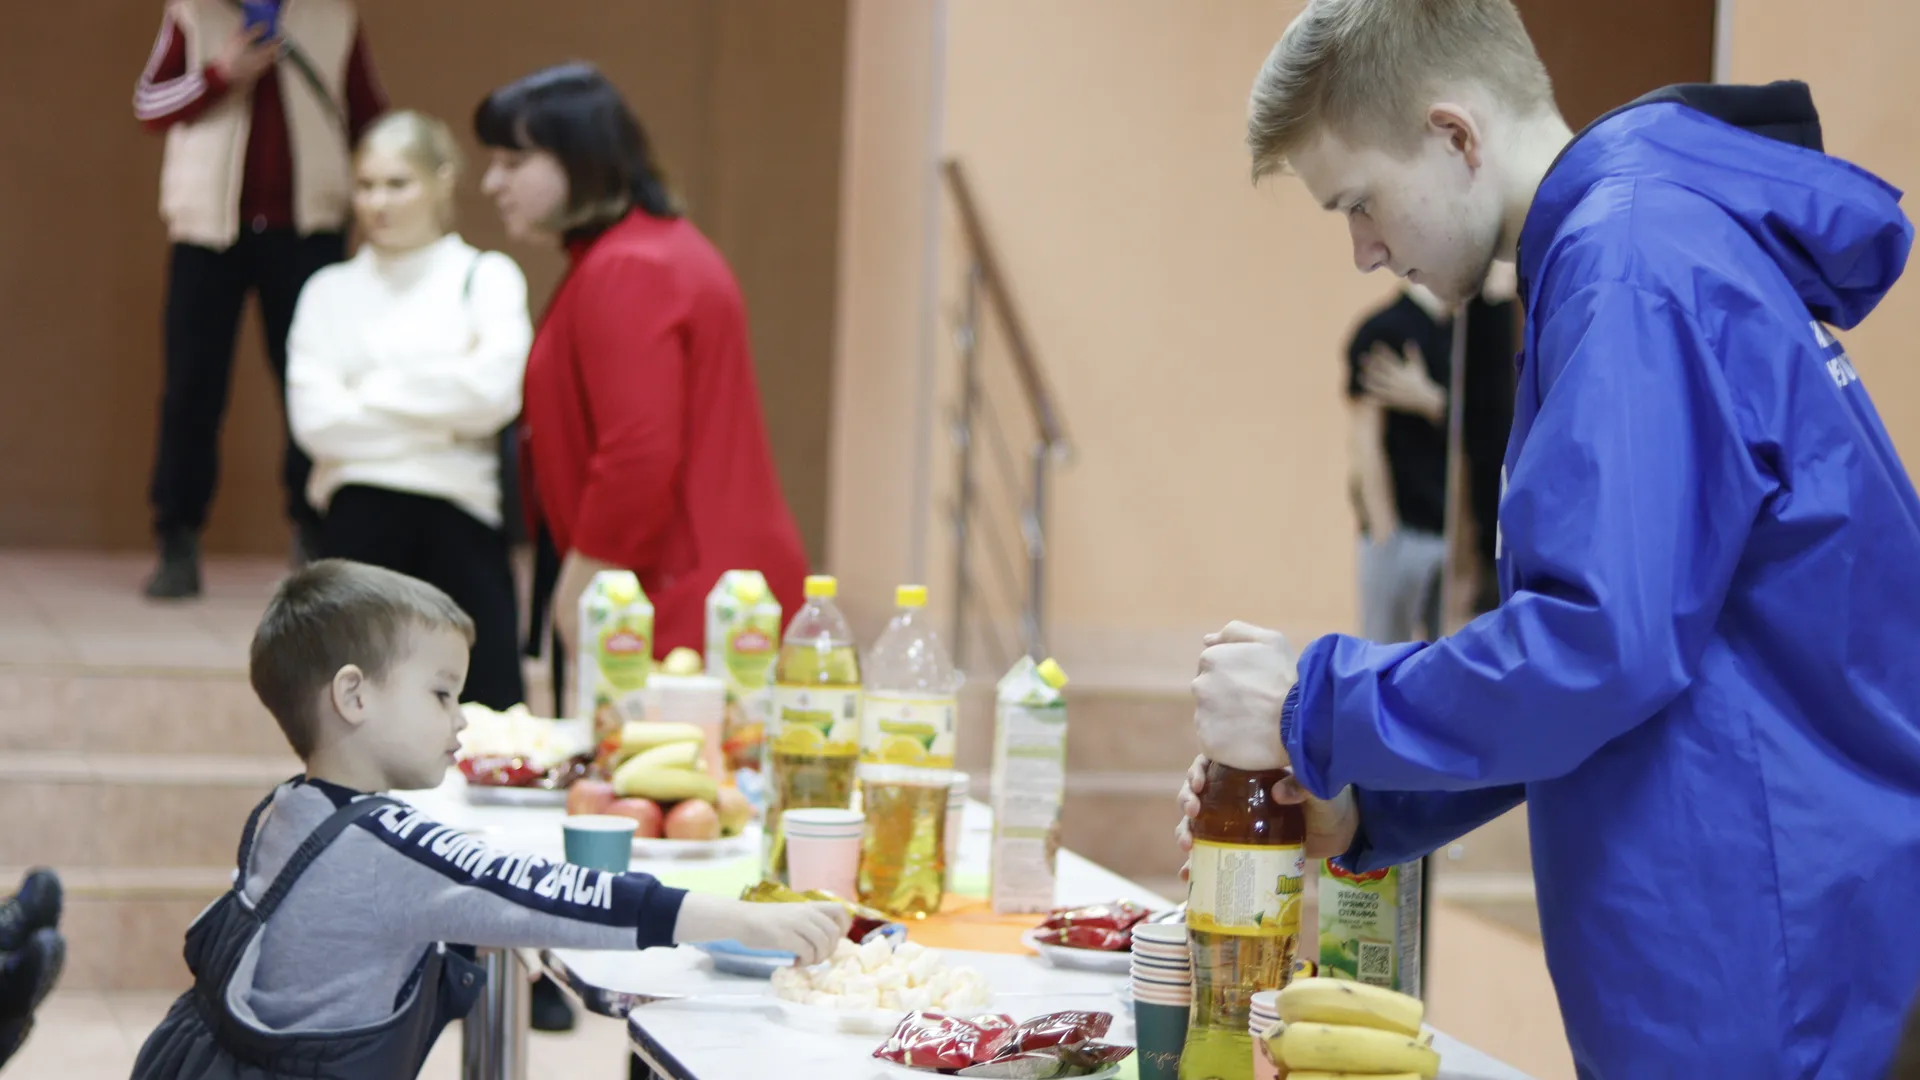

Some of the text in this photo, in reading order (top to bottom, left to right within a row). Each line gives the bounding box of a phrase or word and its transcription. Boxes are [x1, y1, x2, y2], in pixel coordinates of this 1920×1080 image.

[533, 861, 624, 910] BACK
[1337, 891, 1379, 900] ЯБЛОКО
[1338, 909, 1377, 917] ОТЖИМА
